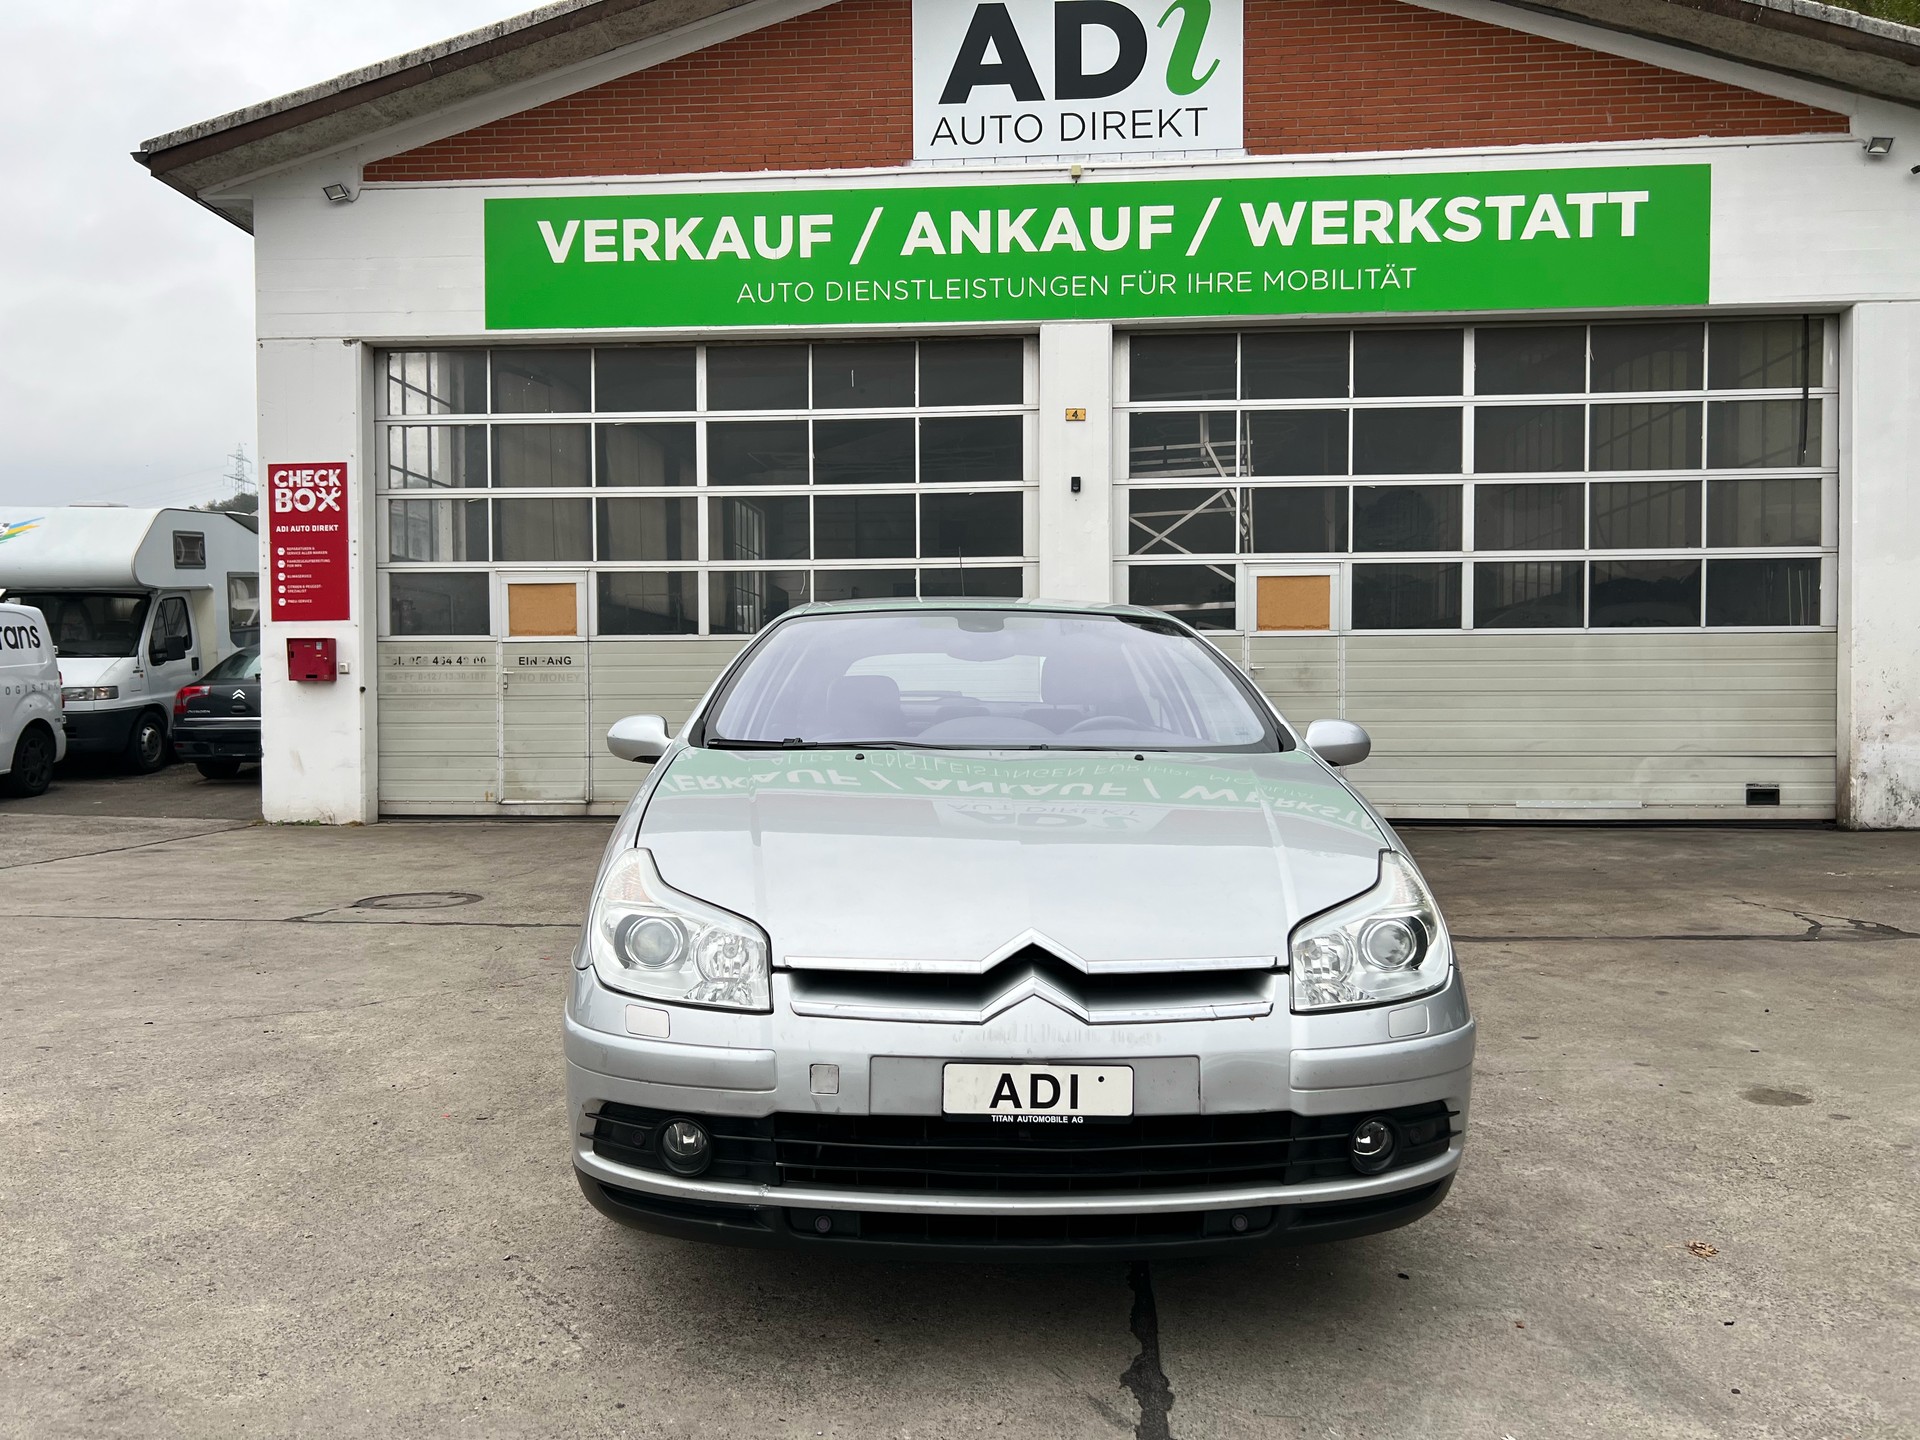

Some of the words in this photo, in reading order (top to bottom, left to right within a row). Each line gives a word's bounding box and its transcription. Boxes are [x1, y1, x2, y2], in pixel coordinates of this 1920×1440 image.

[930, 113, 1043, 146] AUTO
[1060, 107, 1208, 142] DIREKT
[537, 213, 834, 264] VERKAUF
[849, 207, 884, 265] /
[900, 205, 1175, 256] ANKAUF
[1185, 197, 1222, 256] /
[1240, 190, 1649, 247] WERKSTATT
[737, 281, 815, 304] AUTO
[826, 271, 1109, 302] DIENSTLEISTUNGEN
[1120, 268, 1177, 296] FÜR
[1187, 271, 1253, 294] IHRE
[1263, 263, 1417, 292] MOBILITÄT
[1072, 410, 1078, 419] 4
[273, 469, 342, 488] CHECK
[276, 525, 289, 533] ADI
[312, 524, 339, 532] DIREKT
[518, 656, 572, 666] EINANG
[989, 1073, 1079, 1110] ADI
[991, 1114, 1014, 1123] TITAN
[1017, 1115, 1069, 1123] AUTOMOBILE
[1071, 1115, 1084, 1124] AG
